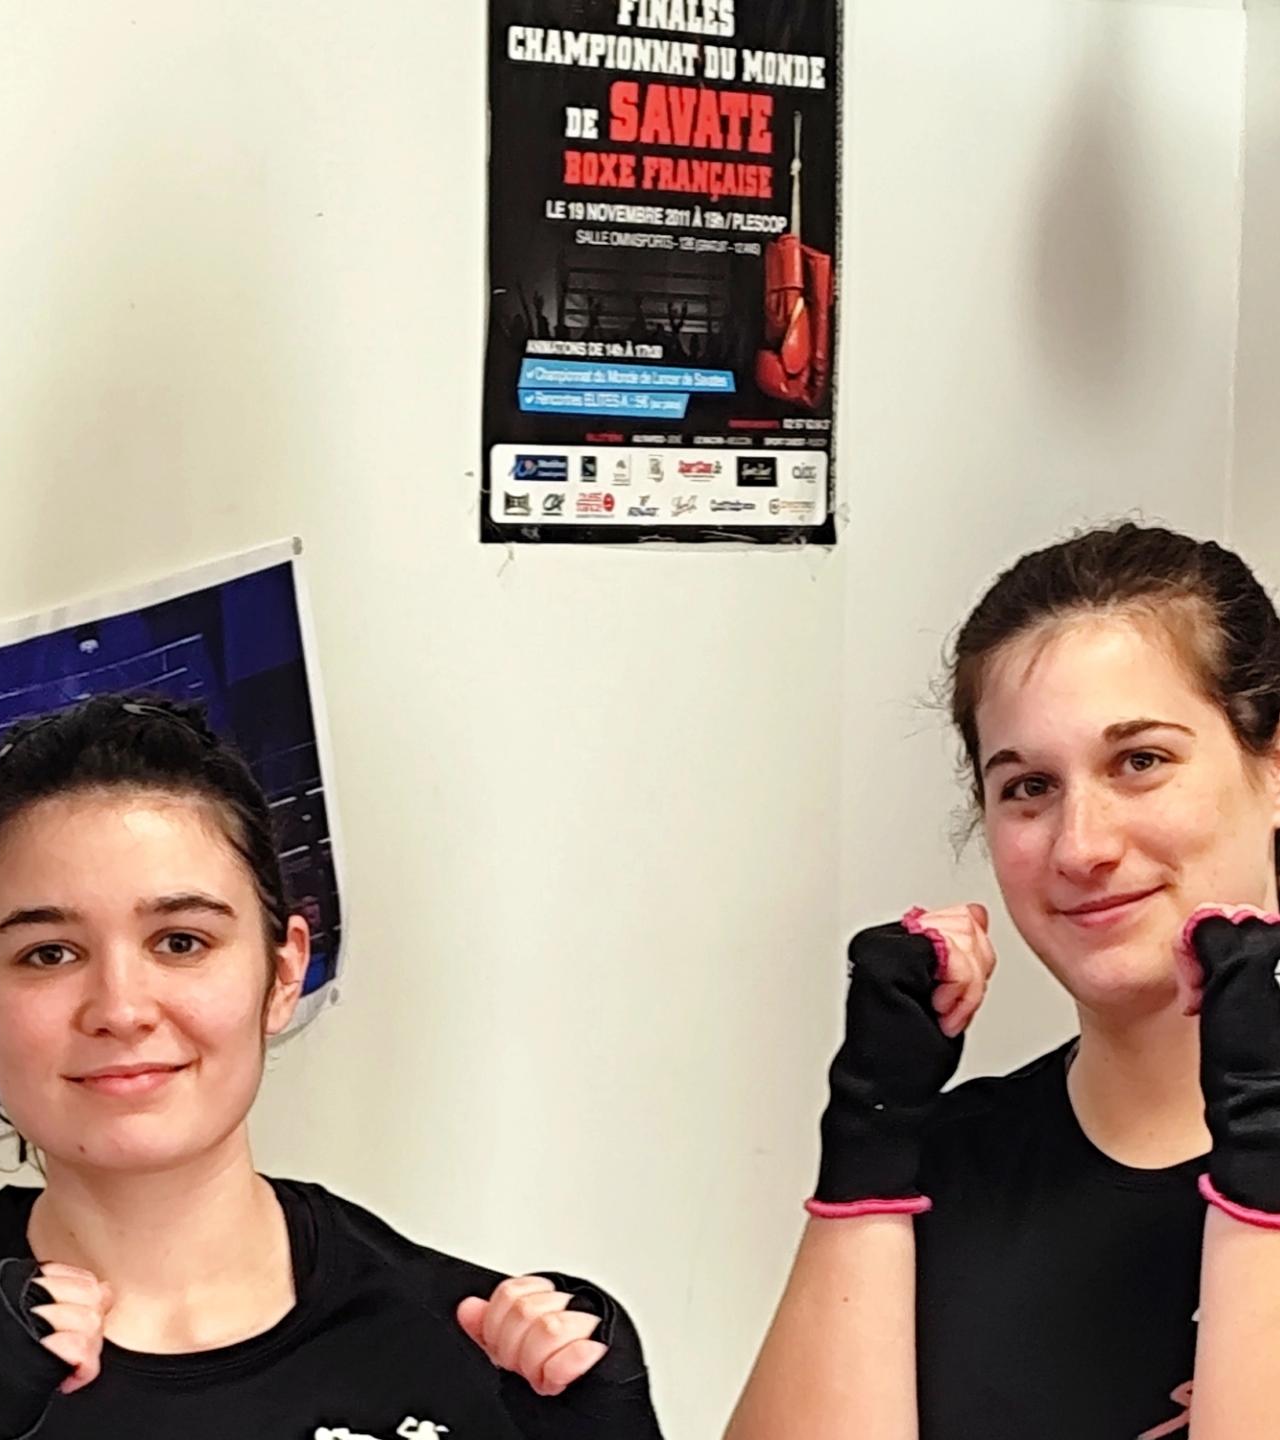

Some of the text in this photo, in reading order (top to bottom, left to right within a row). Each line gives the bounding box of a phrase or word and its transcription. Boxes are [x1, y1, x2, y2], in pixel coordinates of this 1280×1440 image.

[617, 0, 735, 37] FINALES
[508, 25, 826, 89] CHAMPIONNAT DU MONDE
[565, 80, 774, 154] DE SAVATE
[563, 150, 773, 202] BOXE FRANÇAISE
[546, 199, 566, 219] LE
[568, 202, 584, 220] 19
[586, 203, 663, 226] NOVEMBRE
